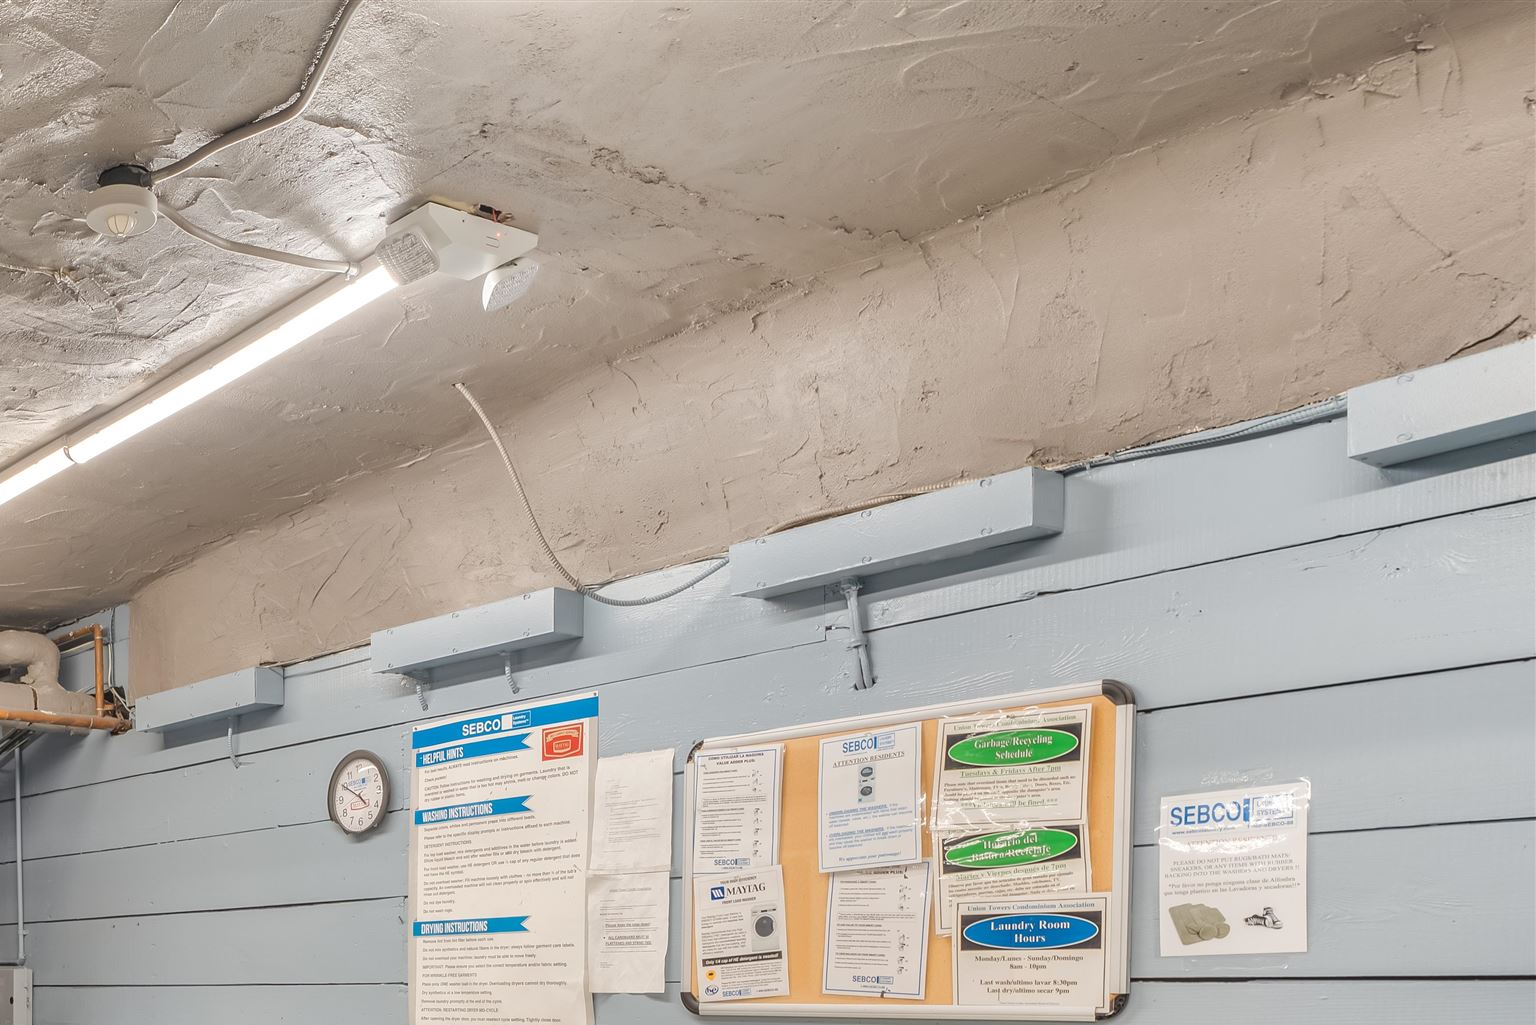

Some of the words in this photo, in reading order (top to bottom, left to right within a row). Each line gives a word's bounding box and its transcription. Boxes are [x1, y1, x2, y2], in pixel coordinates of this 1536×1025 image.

[462, 719, 500, 736] SEBCO
[842, 738, 873, 754] SEBCO
[974, 734, 1053, 749] Garbage/Recycling
[422, 748, 446, 765] HELPFUL
[446, 746, 464, 761] HINTS
[833, 756, 868, 768] ATTENTION
[870, 751, 904, 760] RESIDENTS
[995, 750, 1033, 760] Schedule
[1000, 767, 1026, 775] Fridays
[1047, 765, 1061, 773] 7pm
[374, 774, 378, 782] 2
[376, 786, 381, 794] 3
[338, 796, 344, 804] 9
[374, 800, 379, 808] 4
[343, 809, 348, 817] 8
[368, 811, 373, 820] 5
[422, 809, 448, 822] WASHING
[448, 803, 492, 819] INSTRUCTIONS
[1170, 801, 1241, 826] SEBCO
[350, 816, 354, 825] 7
[358, 817, 363, 826] 6
[1024, 832, 1038, 844] del
[726, 882, 766, 896] MAYTAG
[420, 922, 444, 934] DRYING
[444, 921, 488, 933] INSTRUCTIONS
[990, 921, 1035, 932] Laundry
[1039, 920, 1070, 929] Room
[1014, 934, 1046, 943] Hours
[852, 975, 876, 983] SEBCO
